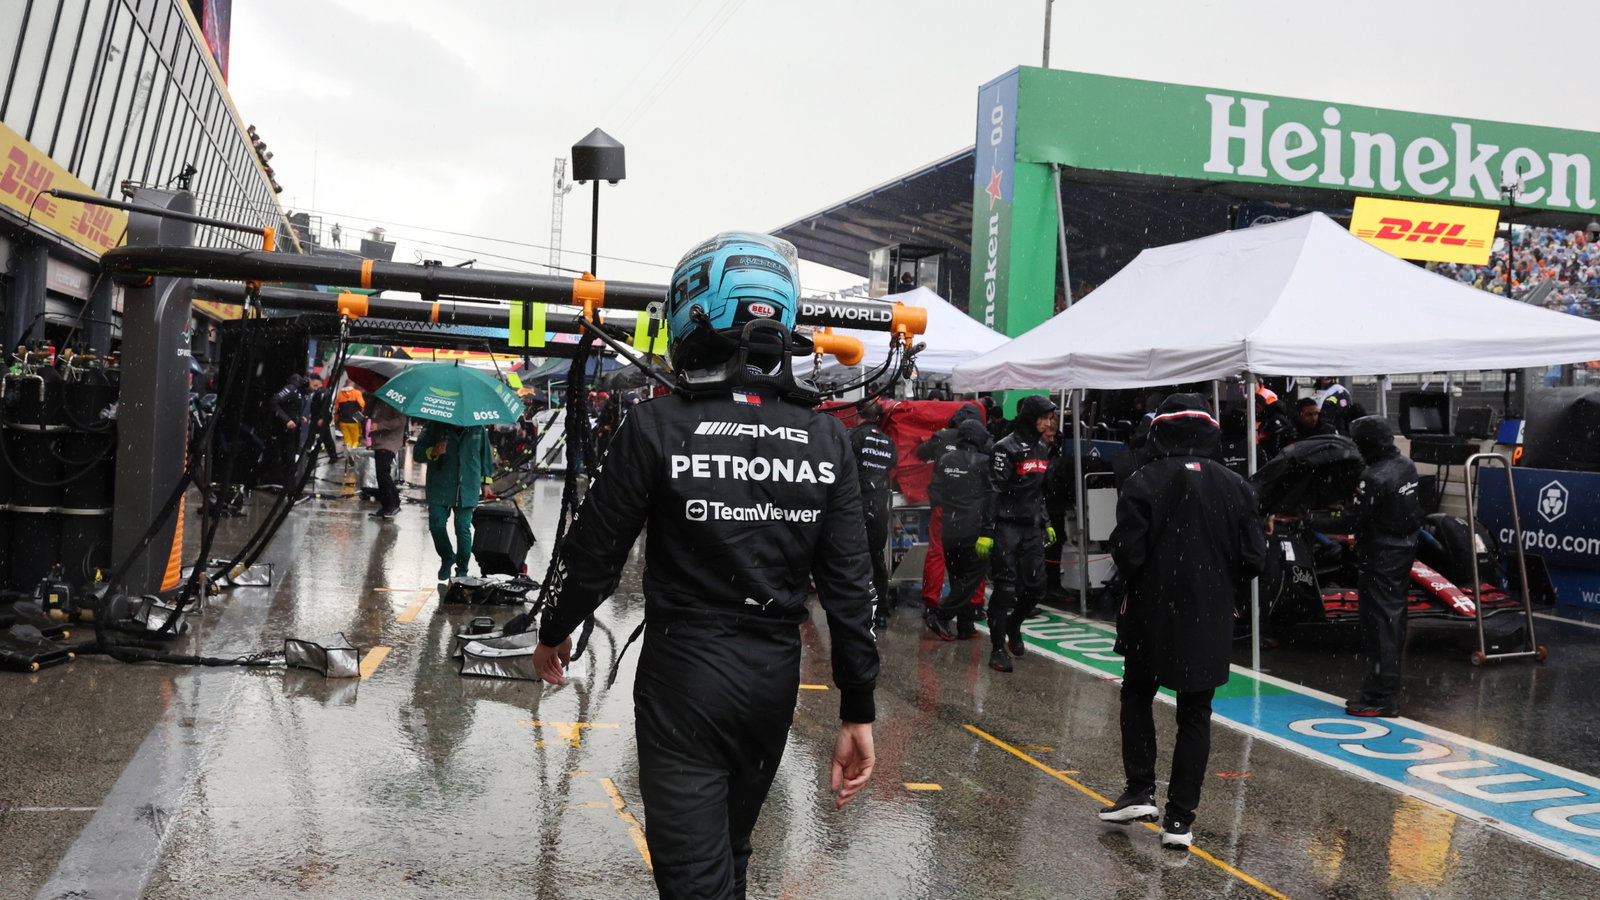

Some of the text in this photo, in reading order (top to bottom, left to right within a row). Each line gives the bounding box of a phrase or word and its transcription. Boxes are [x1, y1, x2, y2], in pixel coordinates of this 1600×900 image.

[1204, 94, 1597, 209] Heineken
[0, 146, 54, 213] DHL
[78, 203, 113, 247] DHL
[1375, 217, 1468, 246] DHL
[984, 213, 999, 331] neken
[671, 258, 712, 316] 63
[751, 305, 772, 315] BELL
[802, 303, 893, 322] DP WORLD
[386, 389, 406, 404] BOSS
[424, 396, 456, 407] cognizant
[420, 407, 453, 418] aramco
[473, 411, 500, 420] BOSS
[671, 454, 836, 484] PETRONAS
[709, 502, 822, 523] TeamViewer
[1292, 565, 1313, 586] Stake
